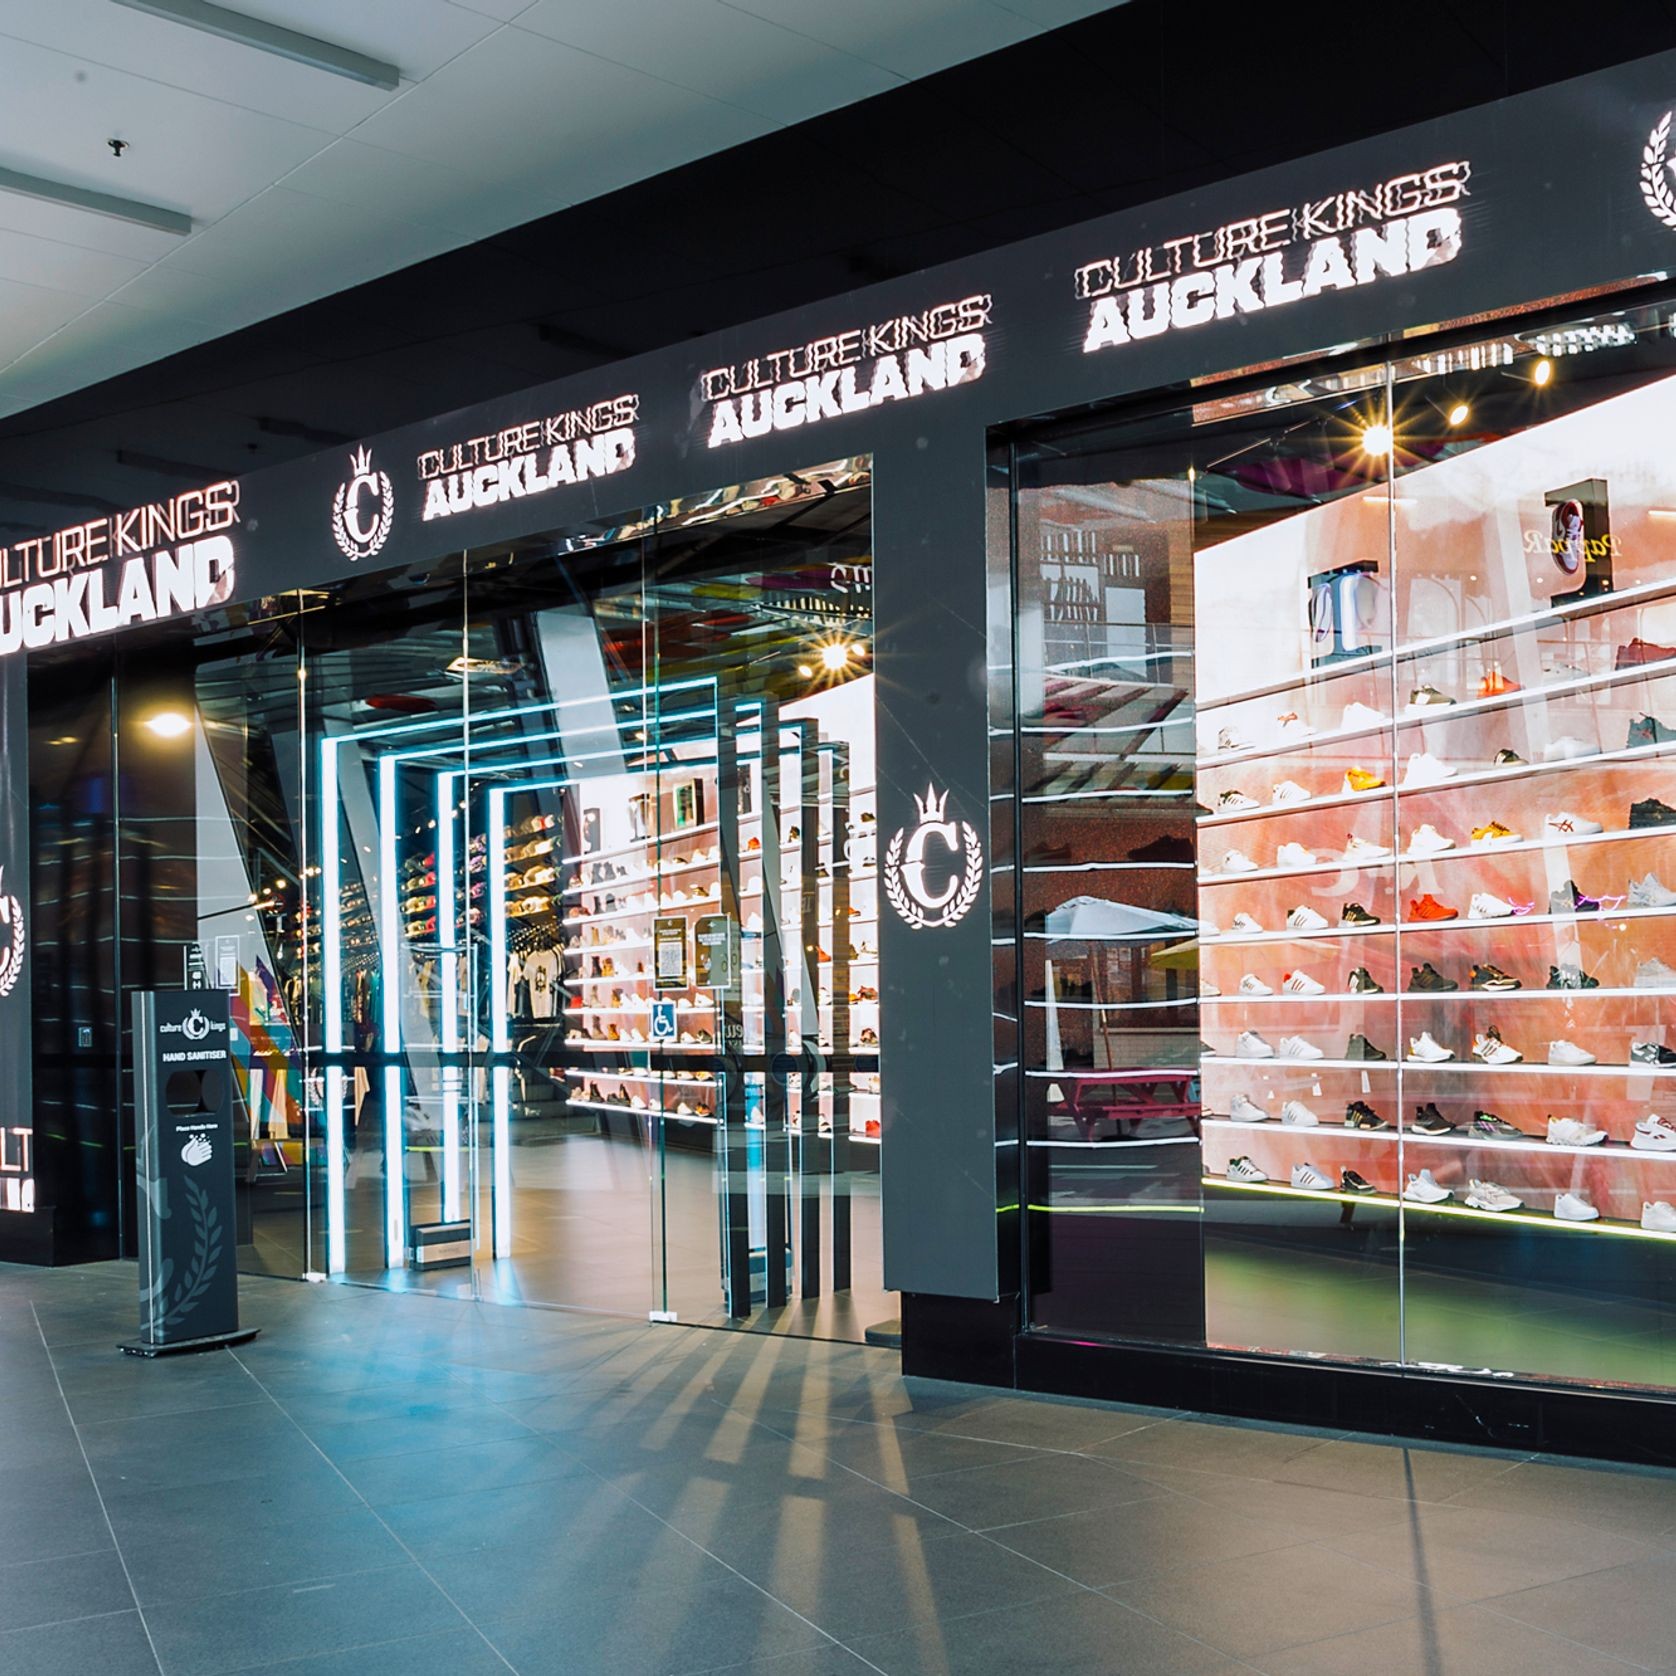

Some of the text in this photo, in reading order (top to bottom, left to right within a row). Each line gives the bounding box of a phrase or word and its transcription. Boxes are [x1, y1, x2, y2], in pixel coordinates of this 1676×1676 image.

[1077, 162, 1470, 299] CULTURE KINGS
[1083, 207, 1461, 353] AUCKLAND
[702, 295, 991, 401] CULTURE KINGS
[708, 333, 985, 448] AUCKLAND
[418, 395, 638, 480] CULTURE KINGS
[423, 428, 635, 521] AUCKLAND
[0, 480, 239, 587] LTURE KINGS
[163, 1050, 227, 1062] HAND SANITISER
